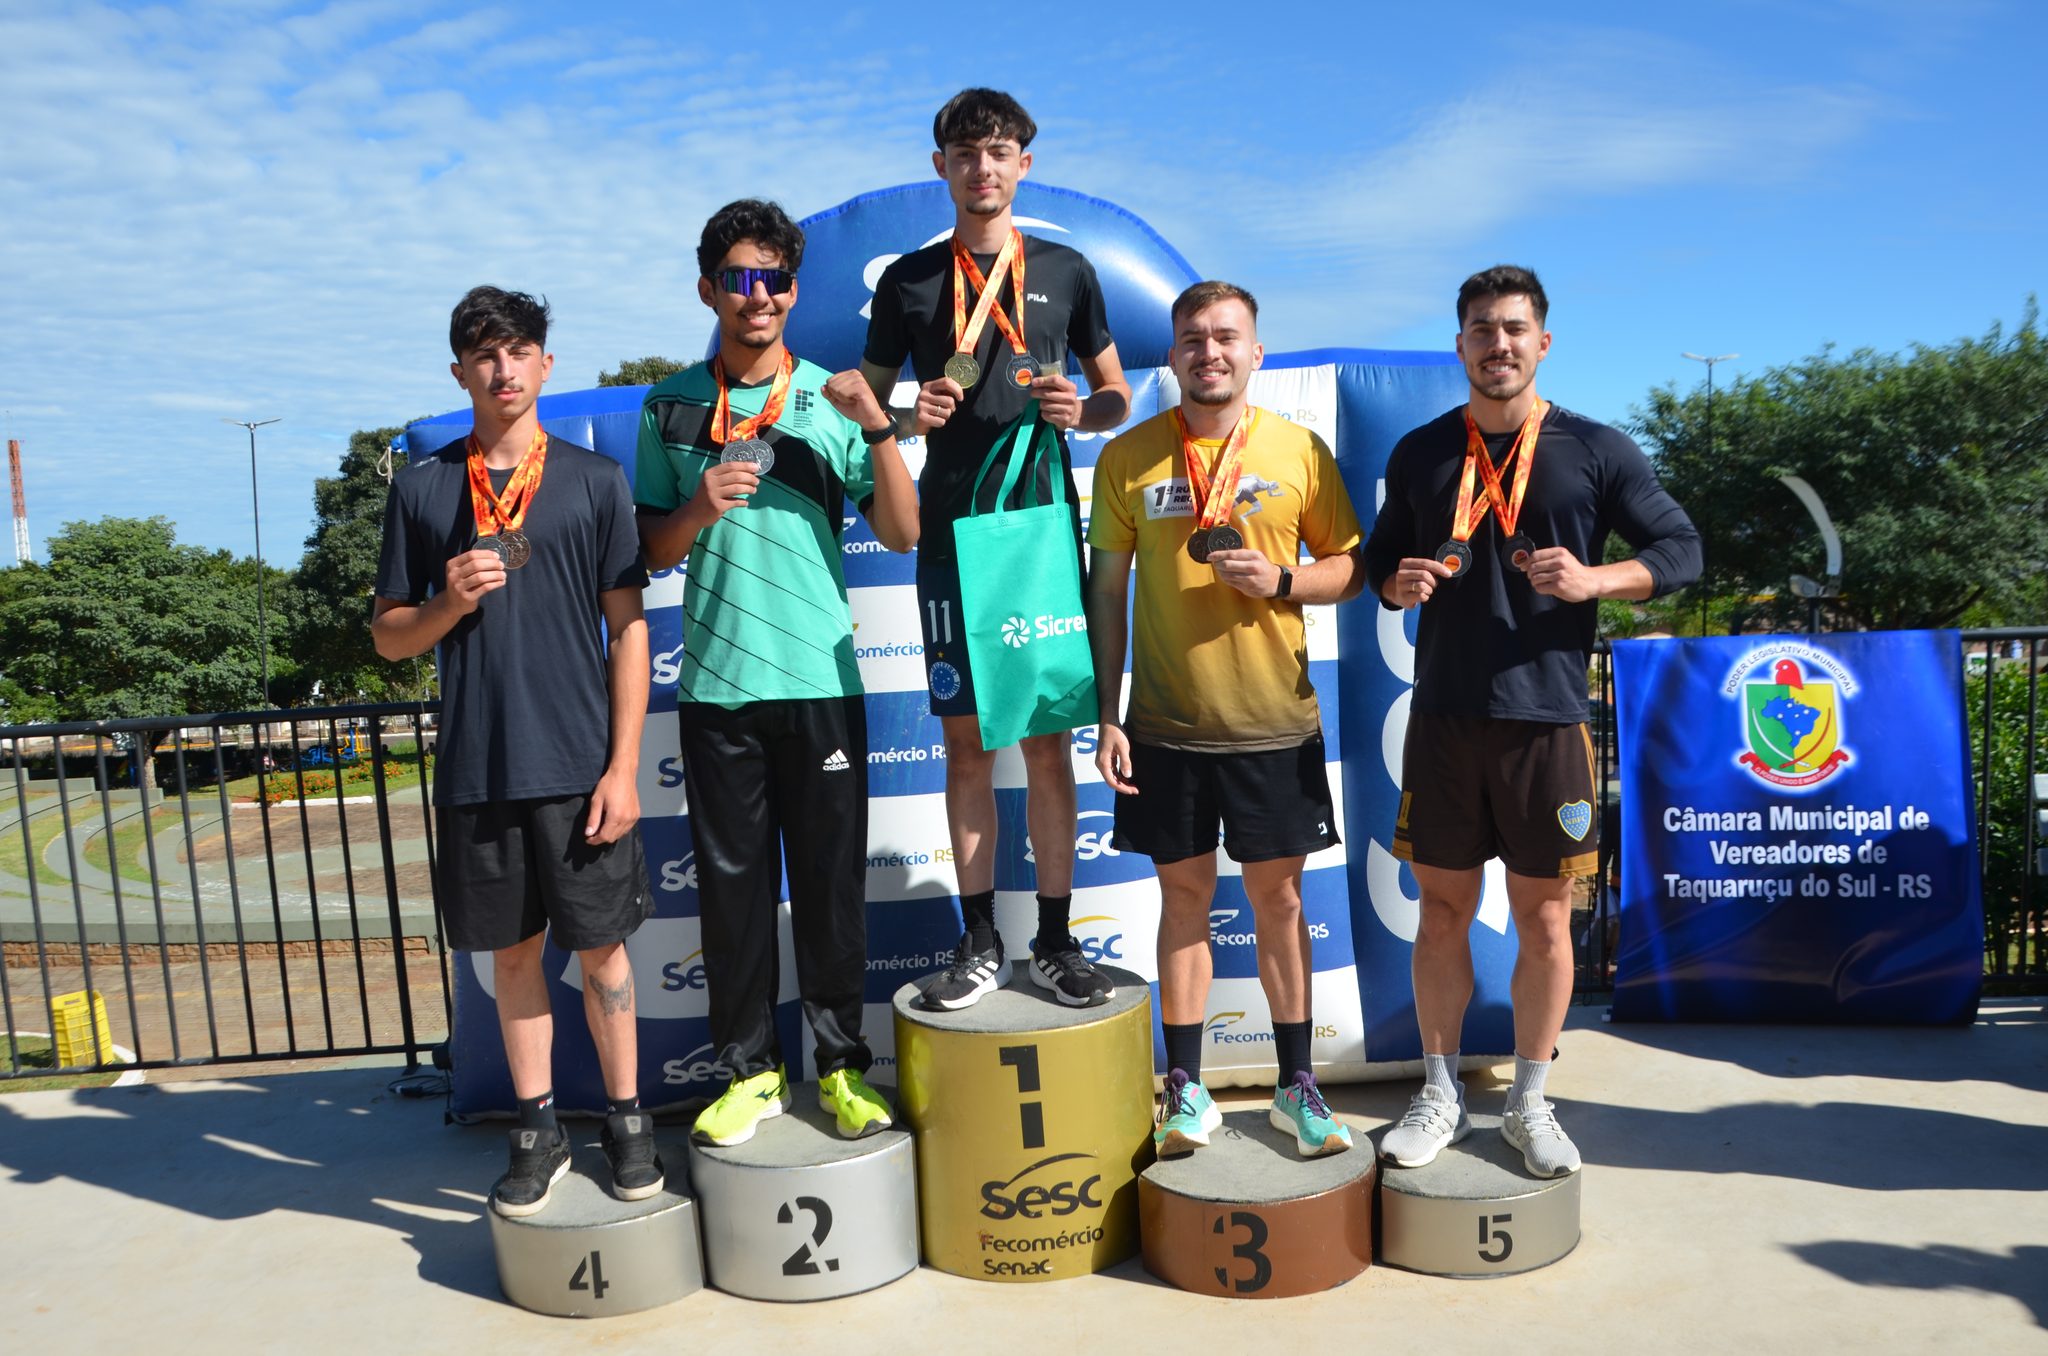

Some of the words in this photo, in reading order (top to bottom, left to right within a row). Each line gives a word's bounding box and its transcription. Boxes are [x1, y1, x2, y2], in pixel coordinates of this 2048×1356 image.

[1027, 293, 1048, 303] FILA
[1296, 409, 1317, 422] RS
[1175, 485, 1192, 494] RÚ
[1163, 505, 1194, 513] TAQUARU
[928, 600, 953, 644] 11
[1034, 614, 1088, 639] Sicre
[855, 642, 924, 659] omércio
[1726, 662, 1748, 694] PODER
[1747, 645, 1810, 665] LEGISLATIVO
[1812, 652, 1853, 691] MUNICIPAL
[823, 762, 850, 771] adidas
[867, 746, 928, 764] mércio
[1663, 806, 1762, 832] Câmara
[1769, 805, 1892, 836] Municipal
[1898, 805, 1930, 831] de
[866, 852, 929, 868] omércio
[1709, 839, 1851, 865] Vereadores
[1857, 839, 1888, 864] de
[1663, 873, 1793, 904] Taquaruçu
[1800, 872, 1830, 897] do
[1837, 873, 1876, 898] Sul
[1898, 873, 1932, 899] RS
[1210, 930, 1257, 946] Fecom
[1309, 923, 1330, 939] RS
[865, 953, 930, 971] omércio
[661, 961, 707, 991] Se
[1213, 1030, 1276, 1044] Fecom
[1315, 1025, 1337, 1038] RS
[663, 1059, 735, 1085] Ses
[999, 1044, 1045, 1149] 1
[777, 1196, 840, 1276] 2
[980, 1225, 1104, 1252] Fecomércio
[1478, 1213, 1513, 1263] 5
[1213, 1211, 1273, 1293] 3
[569, 1250, 609, 1299] 4
[983, 1258, 1051, 1276] Senac
